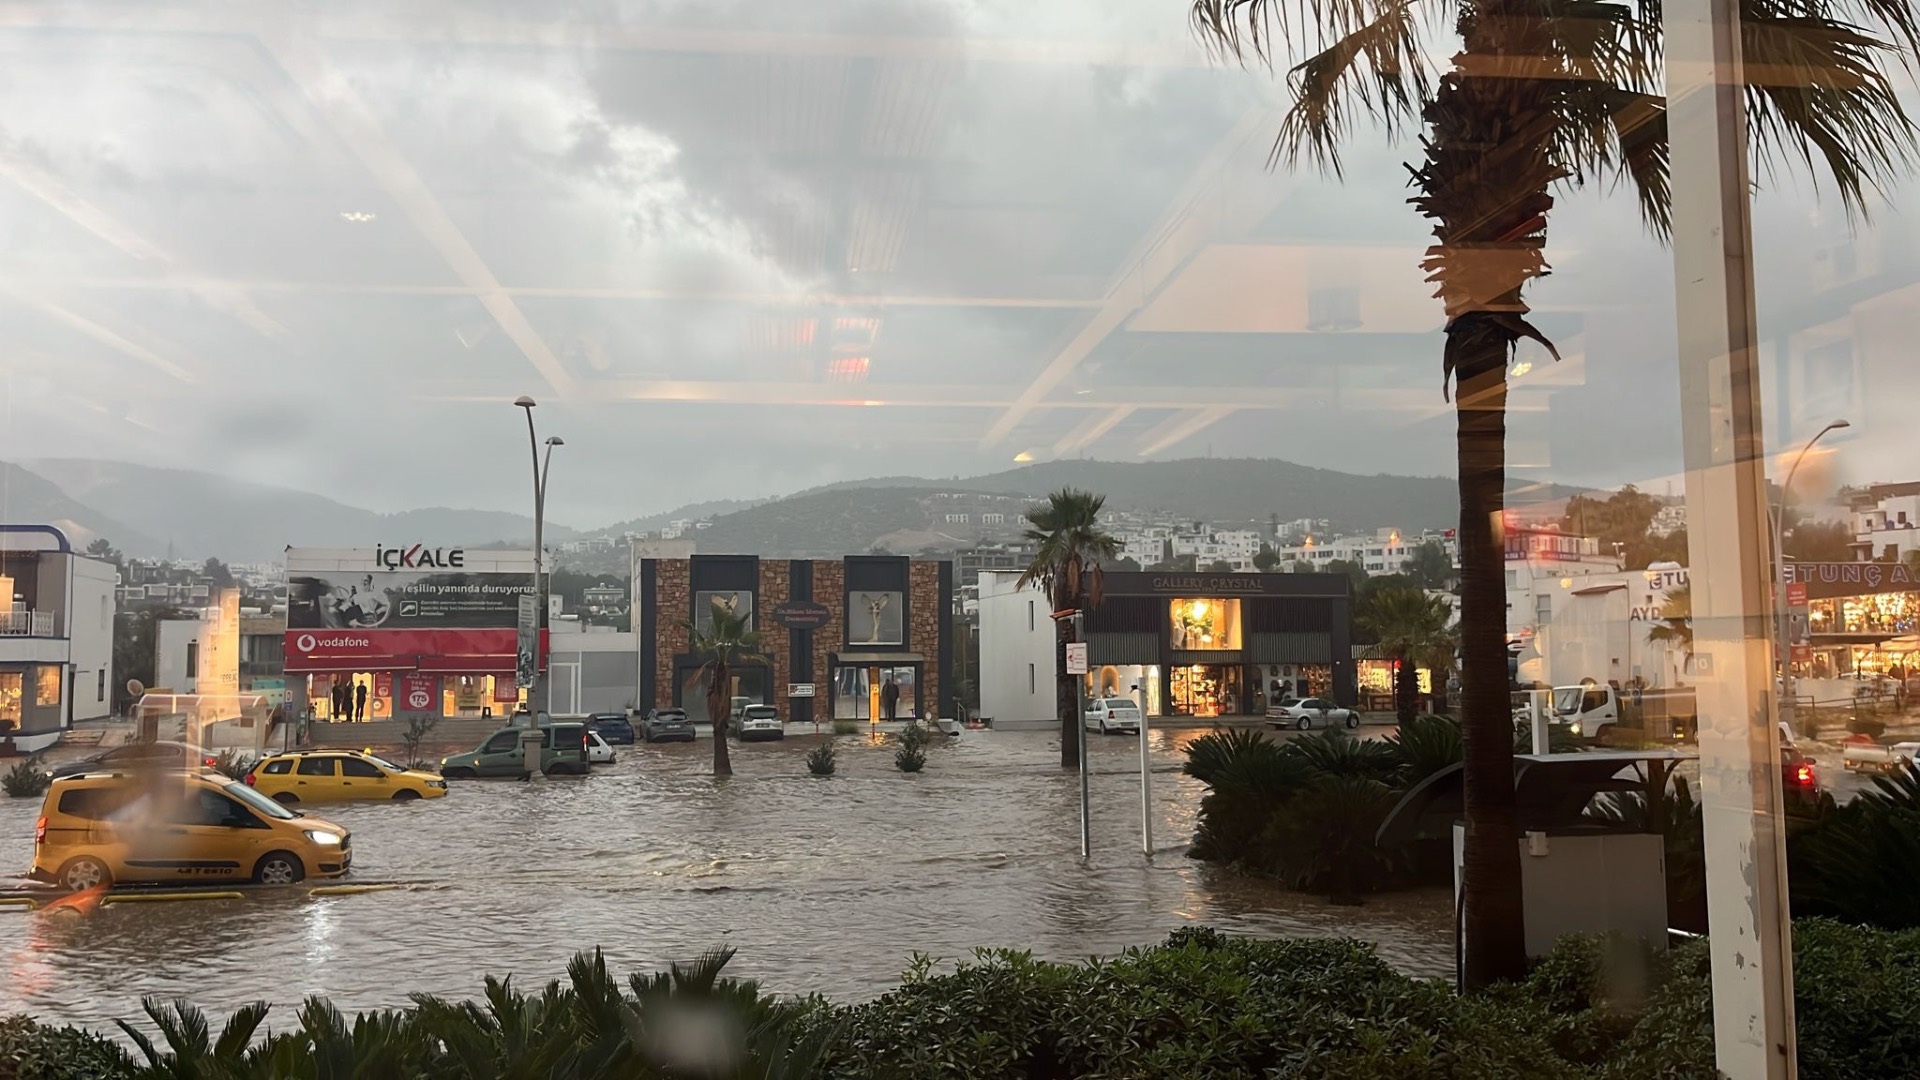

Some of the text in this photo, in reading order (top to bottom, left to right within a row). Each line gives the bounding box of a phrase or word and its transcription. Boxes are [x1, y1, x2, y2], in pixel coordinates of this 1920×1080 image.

[376, 543, 464, 571] İÇKALE
[1153, 577, 1264, 589] GALLERY CRYSTAL
[1663, 571, 1689, 587] TU
[1799, 564, 1920, 587] TUNÇ A
[402, 583, 436, 595] Yeşilin
[438, 583, 480, 595] yanında
[1630, 606, 1661, 621] AYD
[317, 636, 369, 647] vodafone
